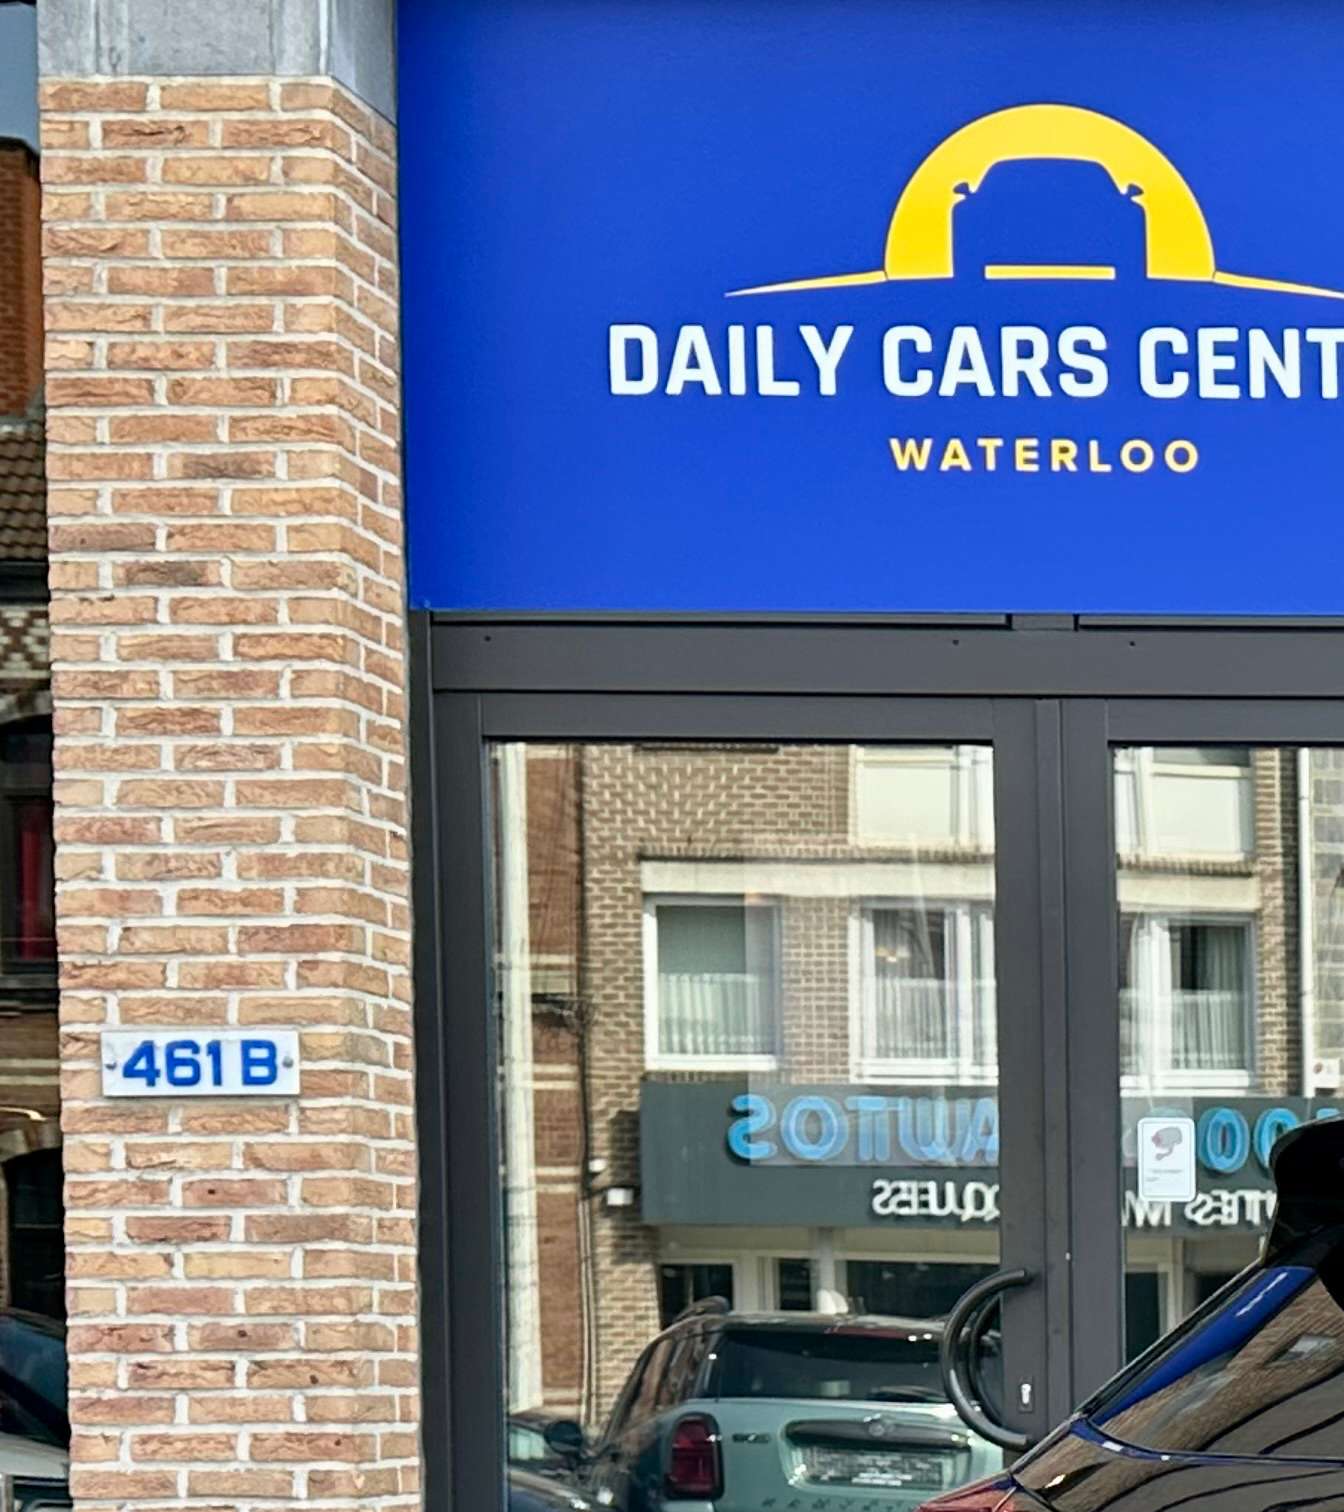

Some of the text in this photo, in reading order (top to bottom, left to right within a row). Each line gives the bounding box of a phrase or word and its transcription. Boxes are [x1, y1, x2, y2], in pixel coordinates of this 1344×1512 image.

[608, 322, 855, 397] DAILY
[881, 324, 1109, 398] CARS
[889, 437, 1200, 474] WATERLOO
[122, 1039, 278, 1087] 461 B
